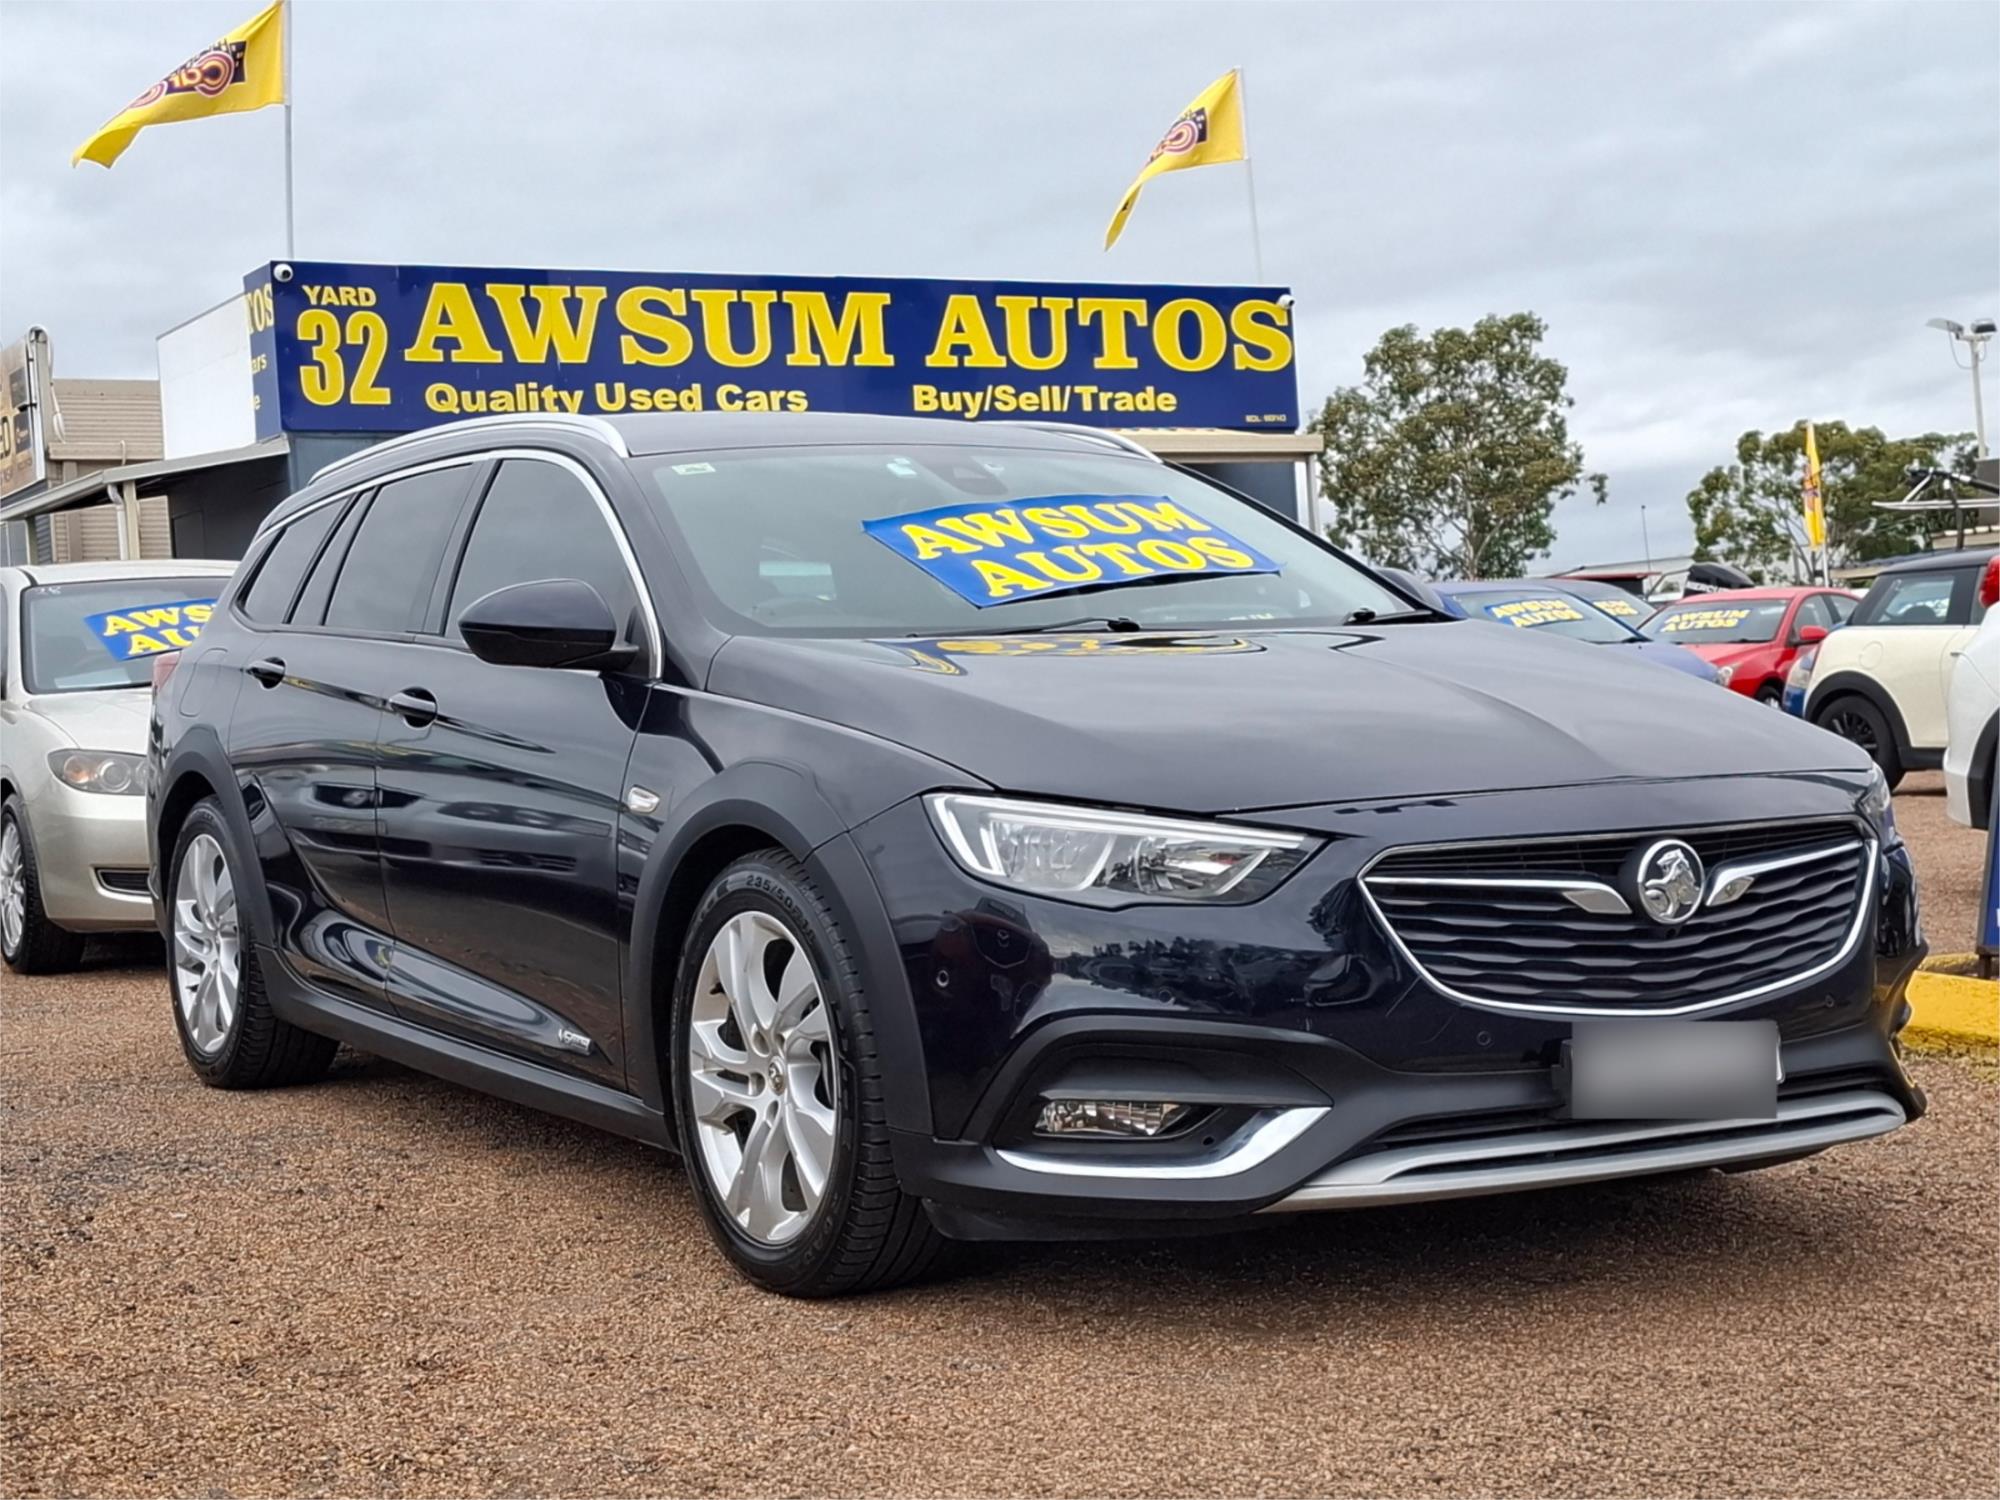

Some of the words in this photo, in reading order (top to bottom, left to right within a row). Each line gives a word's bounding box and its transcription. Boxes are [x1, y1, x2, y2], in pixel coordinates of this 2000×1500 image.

[302, 284, 377, 307] YARD
[404, 282, 895, 368] AWSUM
[924, 294, 1293, 372] AUTOS
[296, 308, 392, 406] 32
[424, 382, 584, 415] Quality
[595, 382, 704, 413] Used
[715, 384, 810, 414] Cars
[912, 384, 1178, 419] Buy/Sell/Trade
[901, 502, 1212, 559] AWSUM
[970, 537, 1255, 597] AUTOS
[103, 604, 216, 636] AWS
